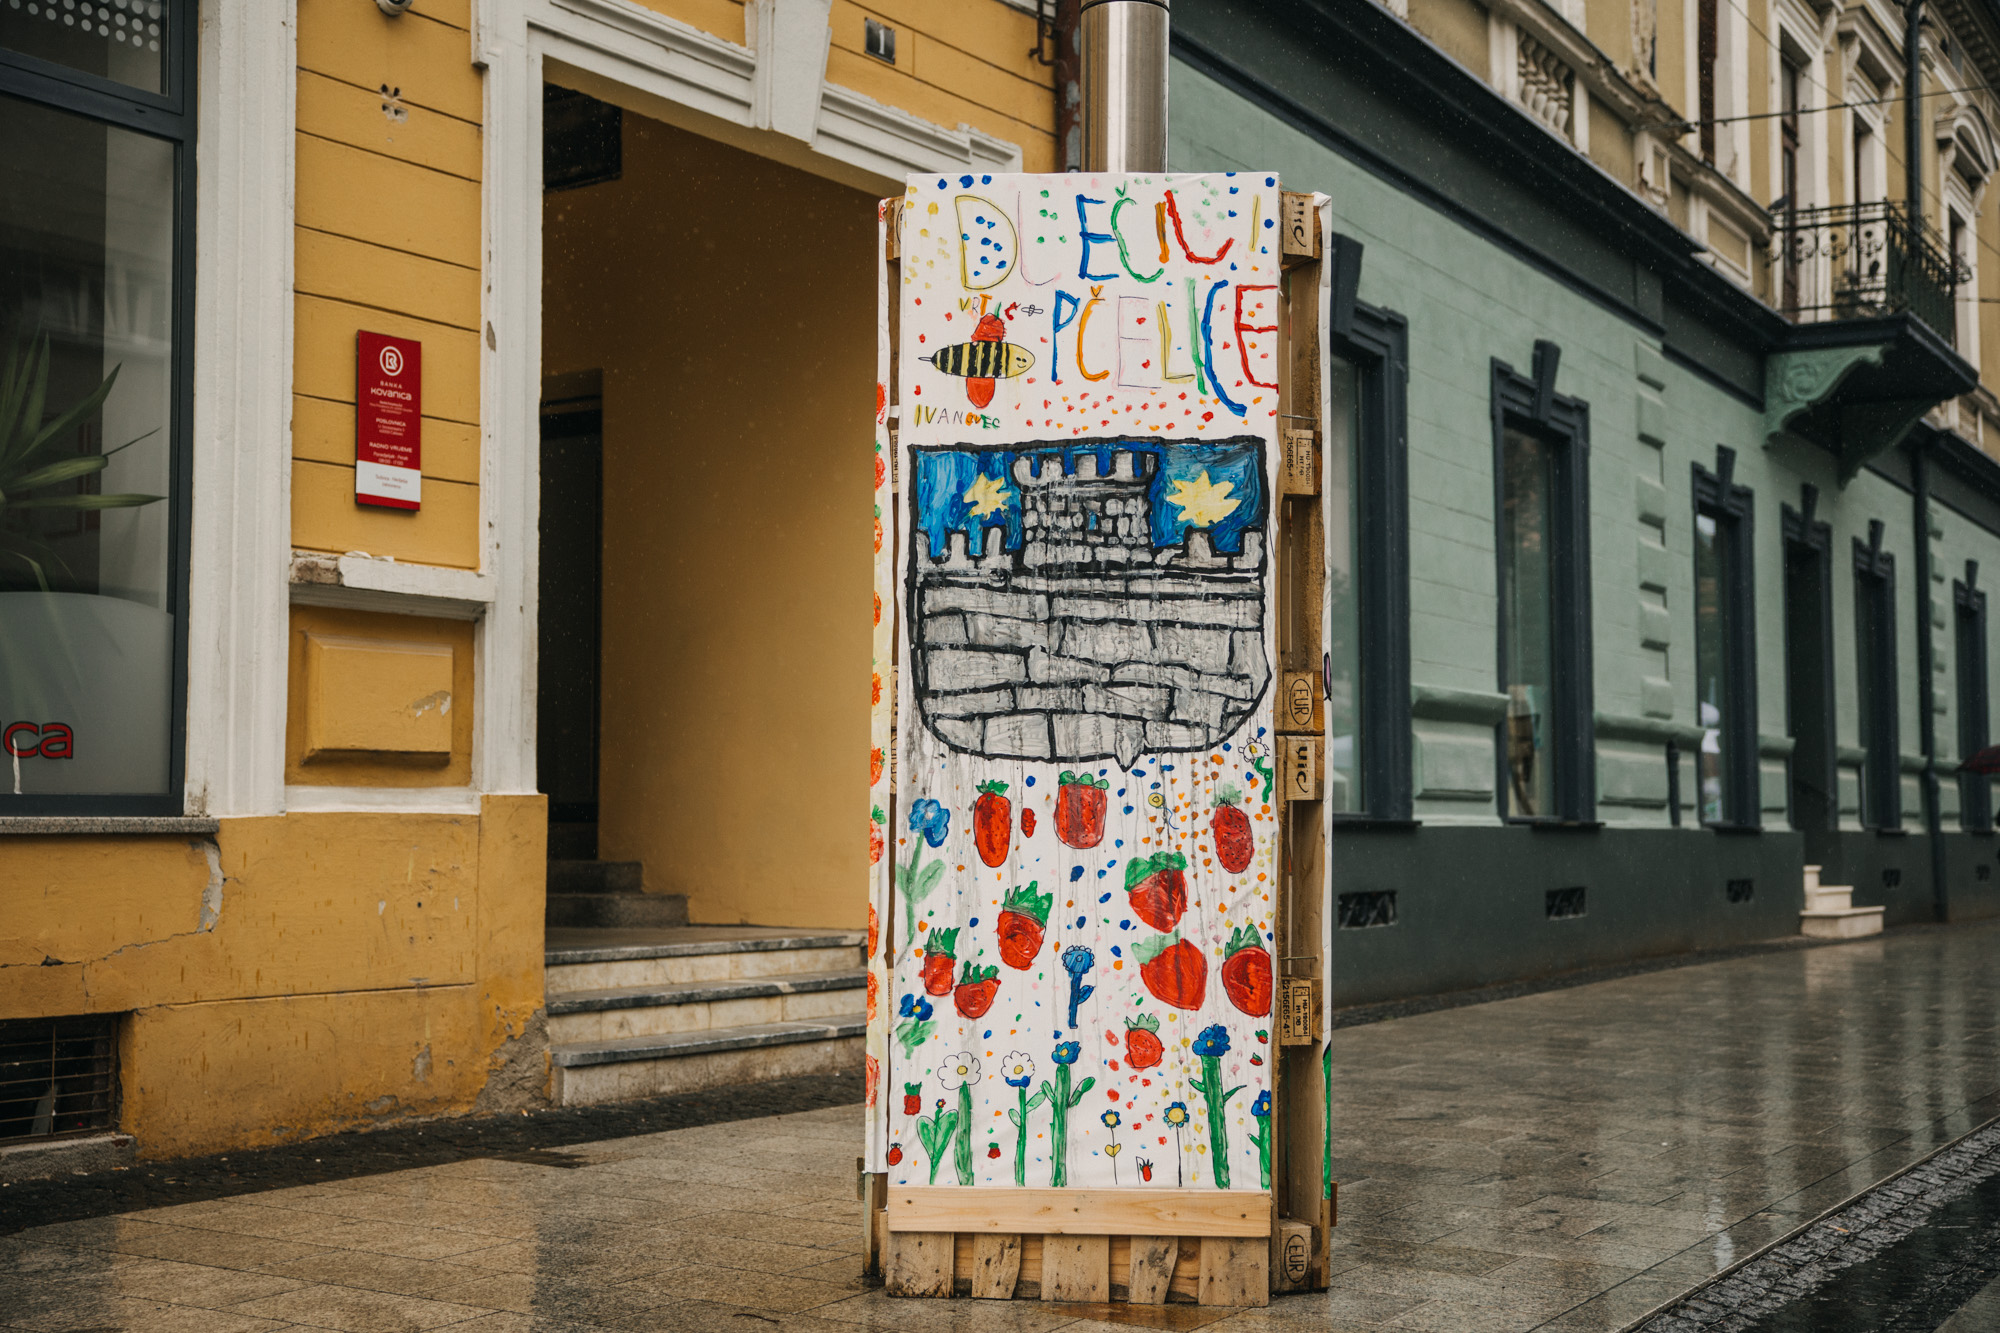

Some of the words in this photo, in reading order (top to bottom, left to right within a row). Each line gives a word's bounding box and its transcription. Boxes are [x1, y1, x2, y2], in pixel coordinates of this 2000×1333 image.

[879, 29, 885, 54] 1
[1051, 278, 1279, 417] PČELICE
[380, 380, 402, 389] BANKA
[1293, 688, 1310, 715] EUR
[1288, 1245, 1305, 1272] EUR
